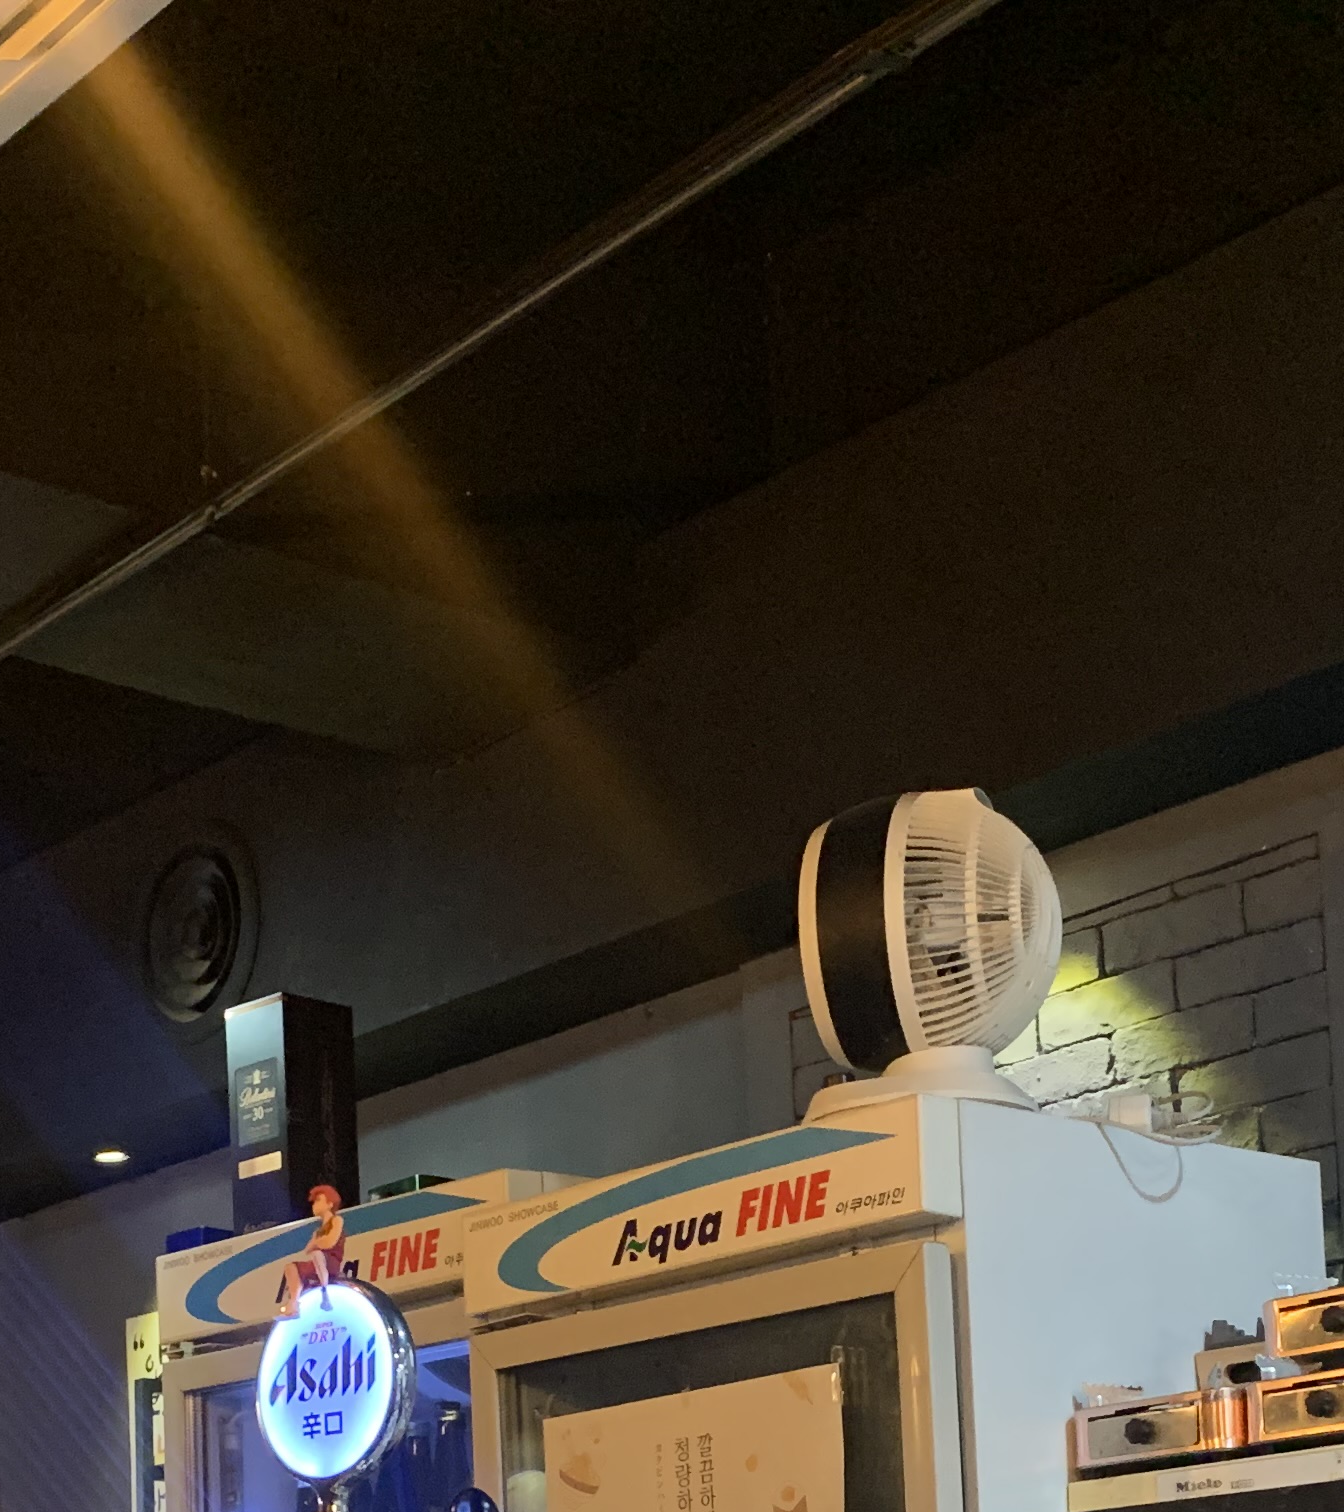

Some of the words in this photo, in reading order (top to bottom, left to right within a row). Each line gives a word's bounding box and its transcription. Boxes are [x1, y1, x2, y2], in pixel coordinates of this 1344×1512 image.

[468, 1215, 504, 1233] JINWOO
[507, 1201, 559, 1223] SHOWCASE
[834, 1186, 906, 1216] 아쿠아파인
[611, 1209, 723, 1266] Aqua
[735, 1169, 832, 1238] FINE
[370, 1227, 441, 1282] FINE
[269, 1333, 377, 1408] Asahi
[302, 1410, 344, 1440] 辛口
[1175, 1478, 1223, 1493] Miele
